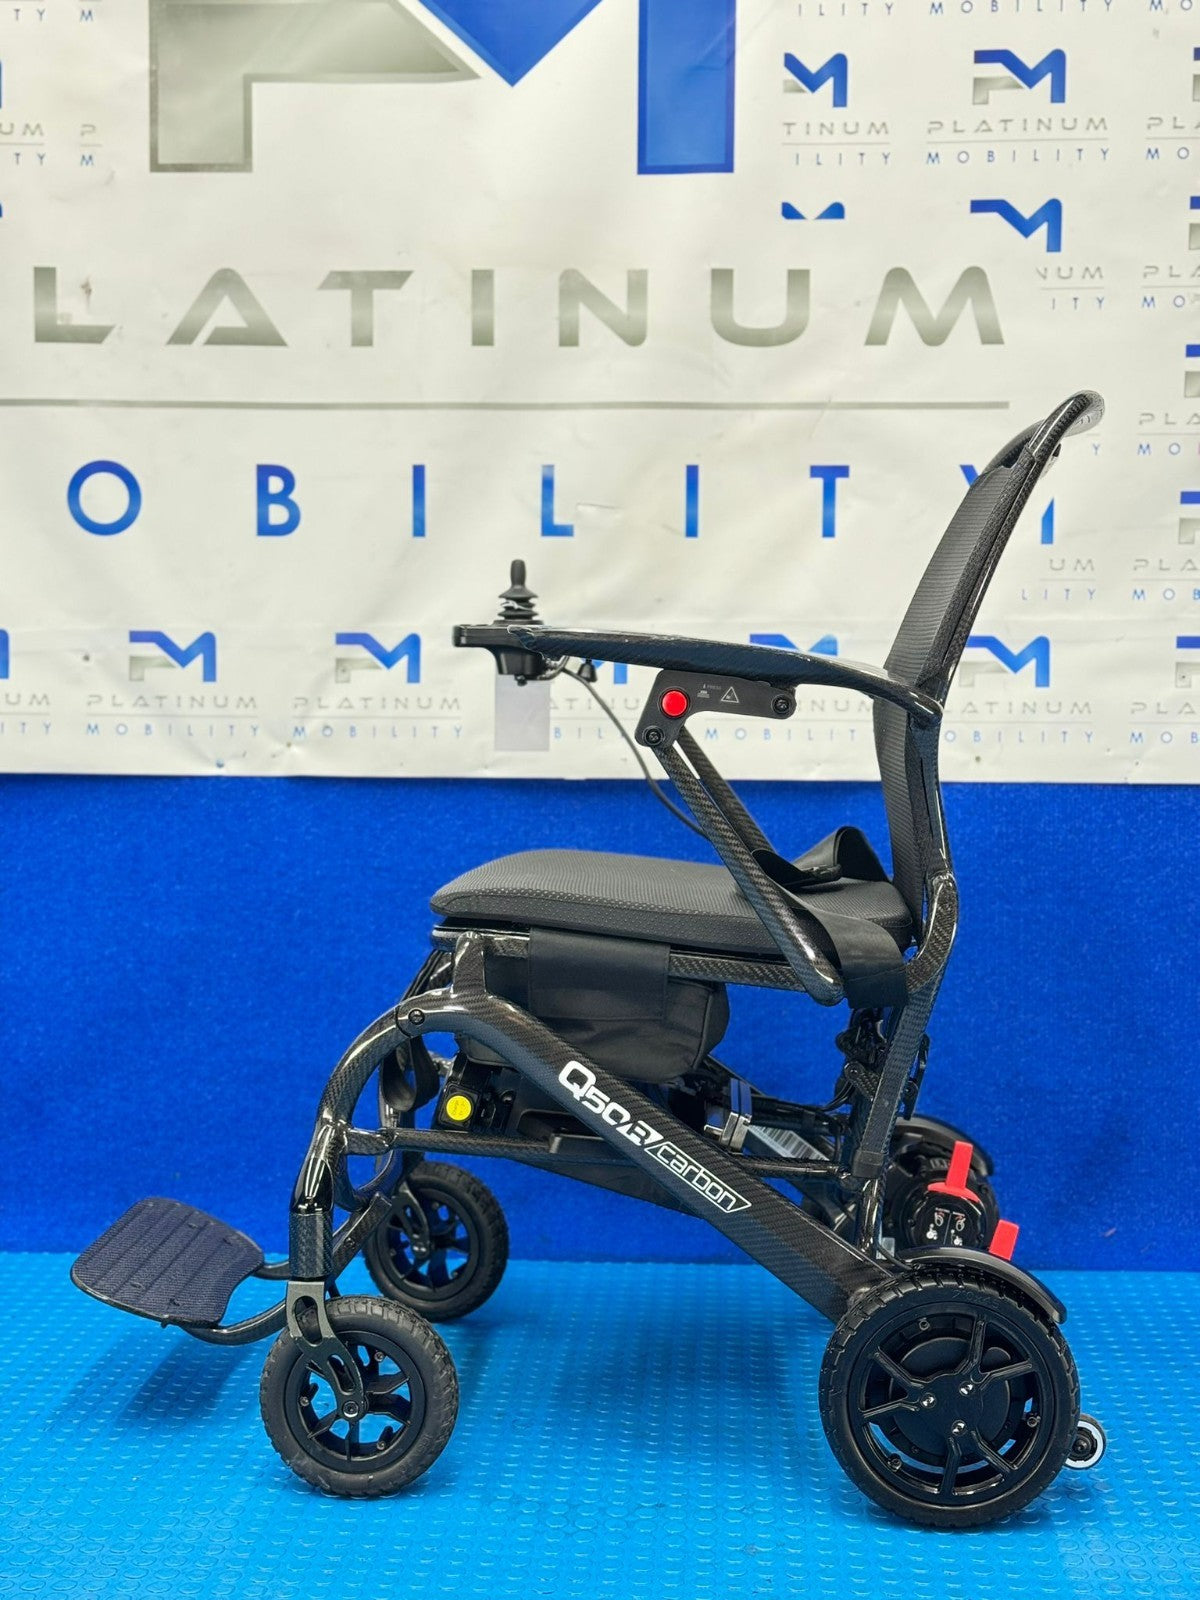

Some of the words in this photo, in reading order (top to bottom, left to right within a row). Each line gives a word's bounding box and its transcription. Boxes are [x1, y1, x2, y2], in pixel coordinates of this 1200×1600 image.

[930, 0, 1112, 14] MOBILITY
[927, 117, 1107, 134] PLATINUM
[926, 149, 1109, 164] MOBILITY
[33, 266, 1004, 348] LATINUM
[87, 695, 257, 708] PLATINUM
[293, 697, 460, 709] PLATINUM
[86, 724, 259, 737] MOBILITY
[293, 725, 462, 738] MOBILITY
[656, 1144, 738, 1211] carbon
